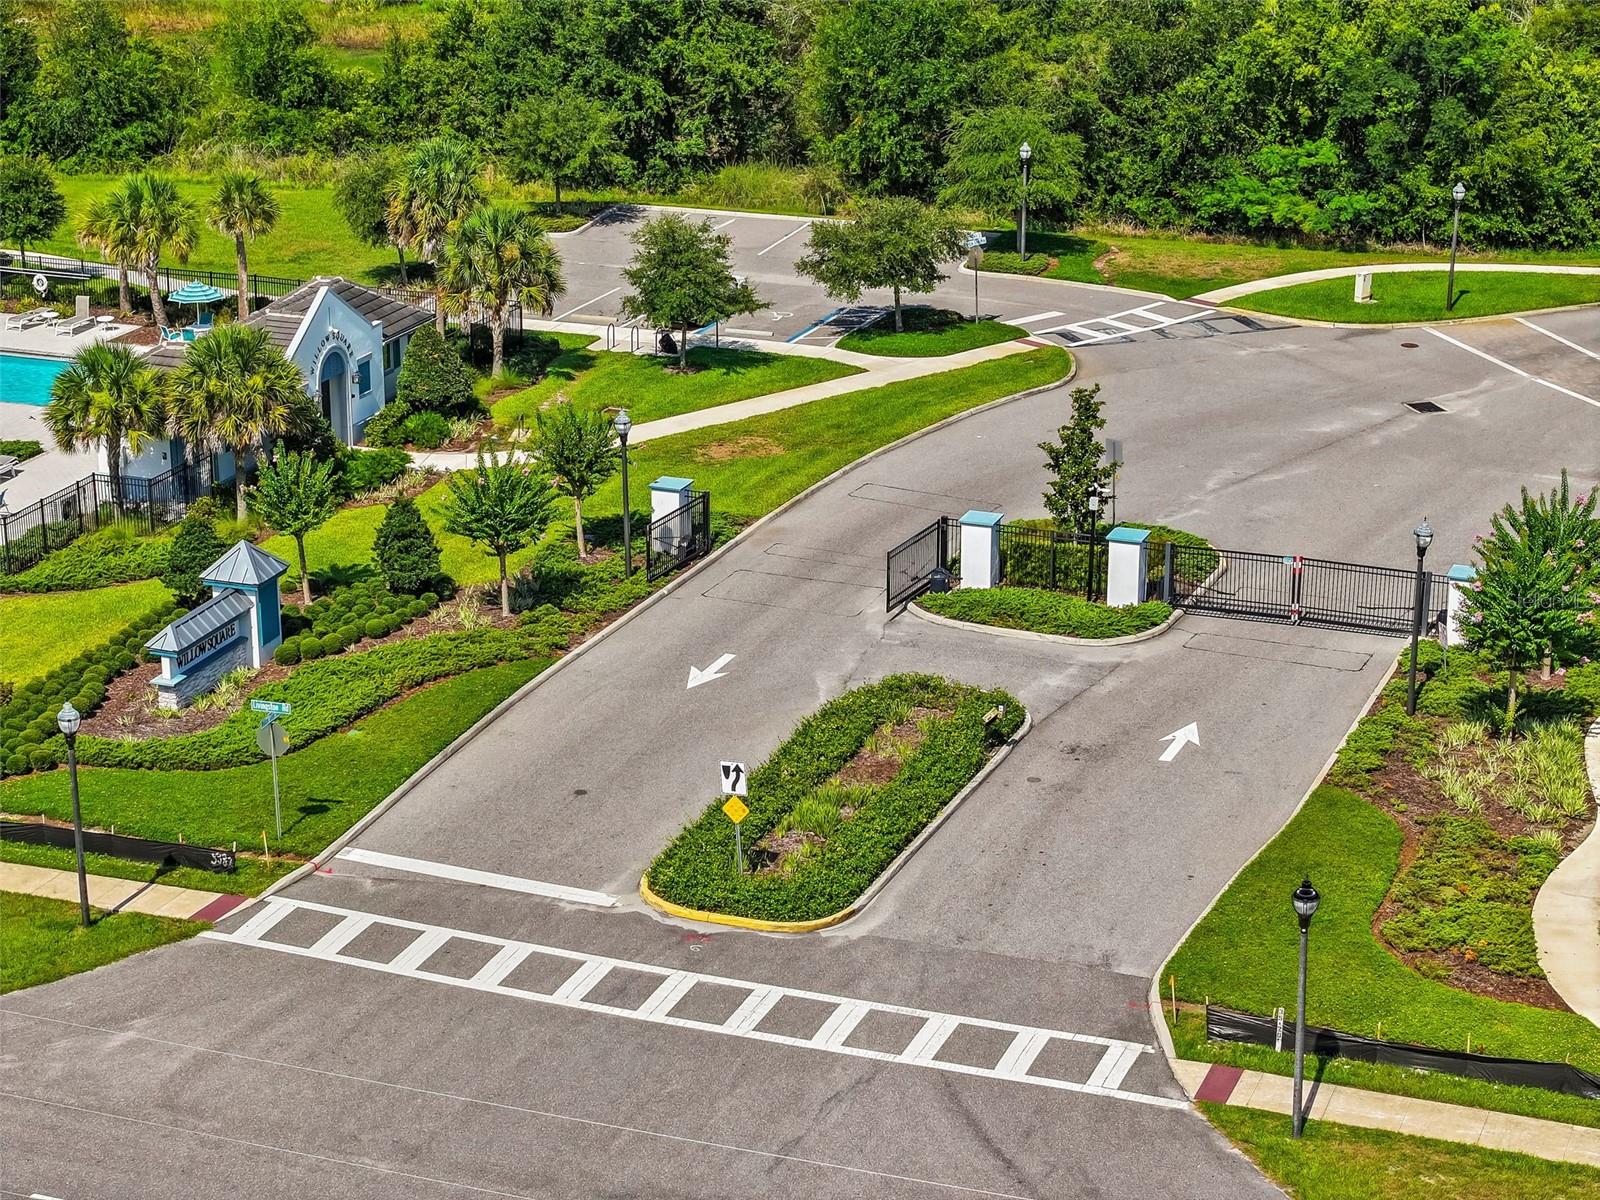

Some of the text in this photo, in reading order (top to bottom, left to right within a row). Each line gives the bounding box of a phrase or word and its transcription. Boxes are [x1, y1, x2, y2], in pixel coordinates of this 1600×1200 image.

[311, 330, 354, 375] WILLOW SQUARE
[176, 623, 236, 670] WILLOW SQUARE
[252, 700, 290, 713] Livingston Rd
